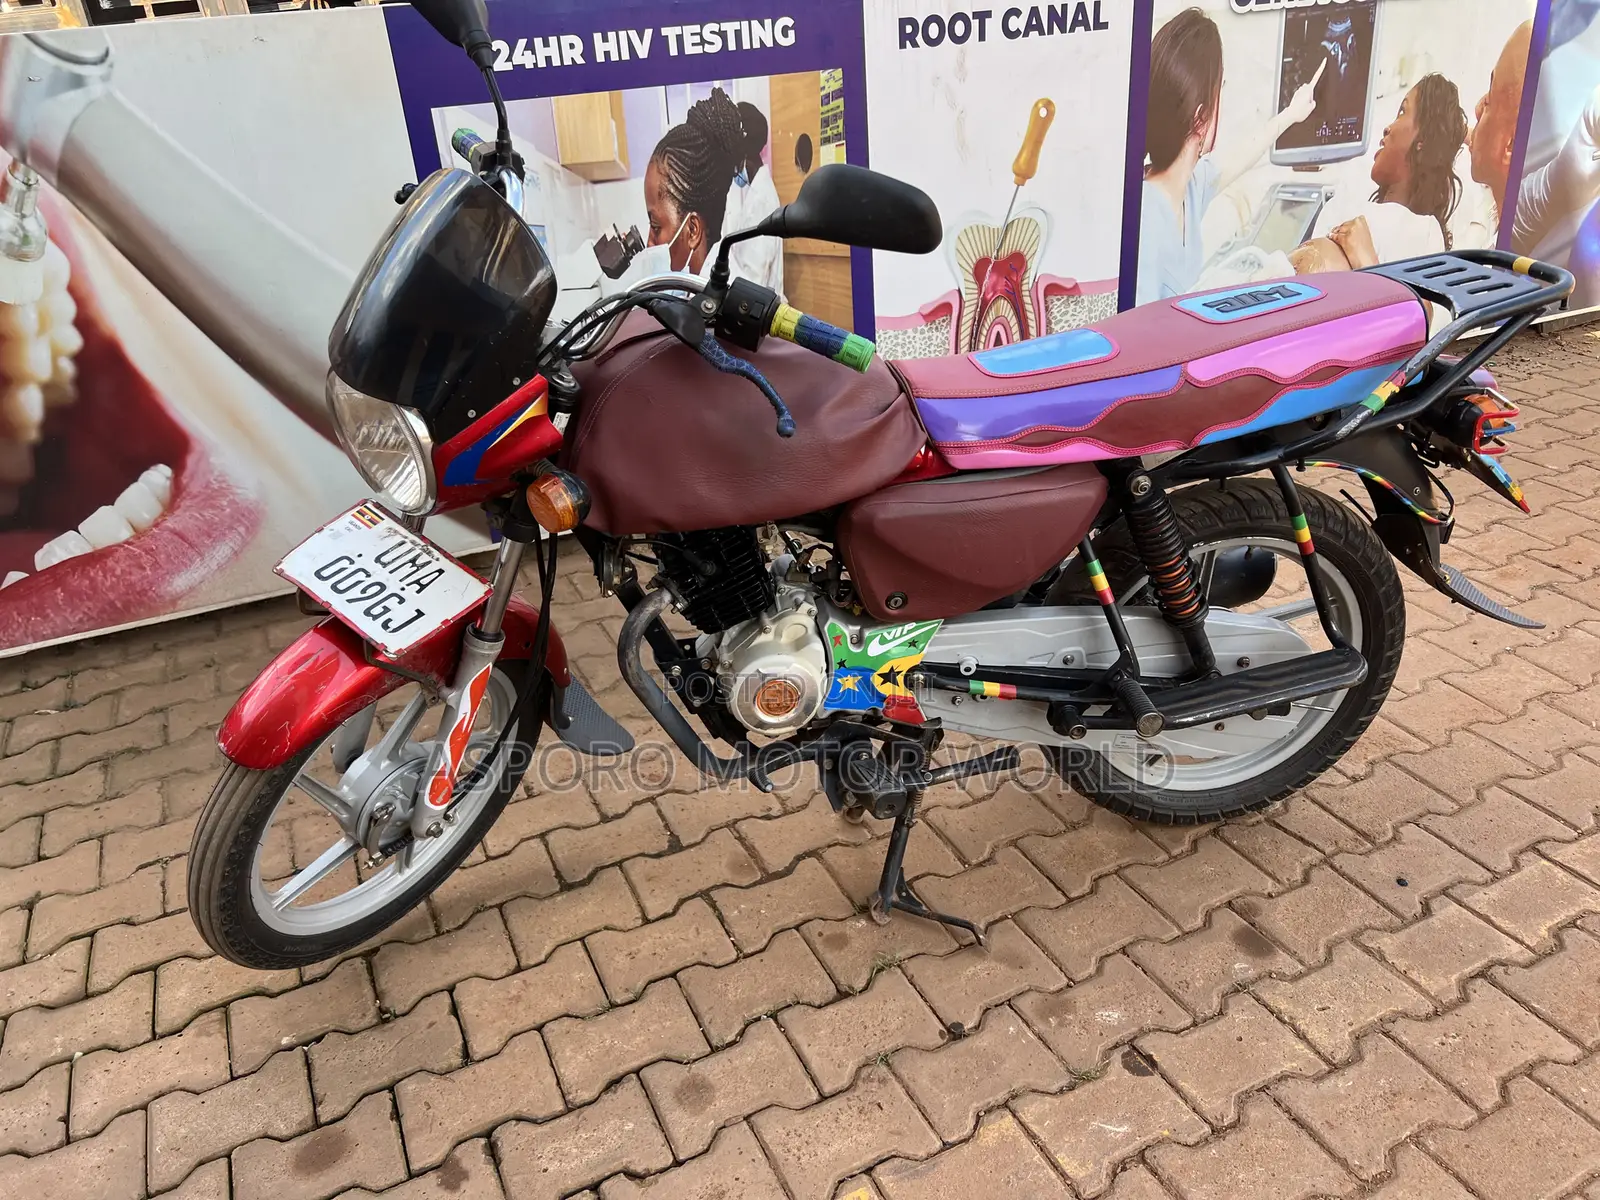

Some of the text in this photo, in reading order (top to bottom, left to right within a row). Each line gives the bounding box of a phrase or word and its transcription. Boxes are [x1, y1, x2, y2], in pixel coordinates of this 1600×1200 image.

[492, 16, 796, 72] 24HR HIV TESTING
[898, 1, 1109, 50] ROOT CANAL
[313, 555, 426, 634] 009GJ
[373, 540, 445, 595] UMA
[883, 622, 917, 640] VIP
